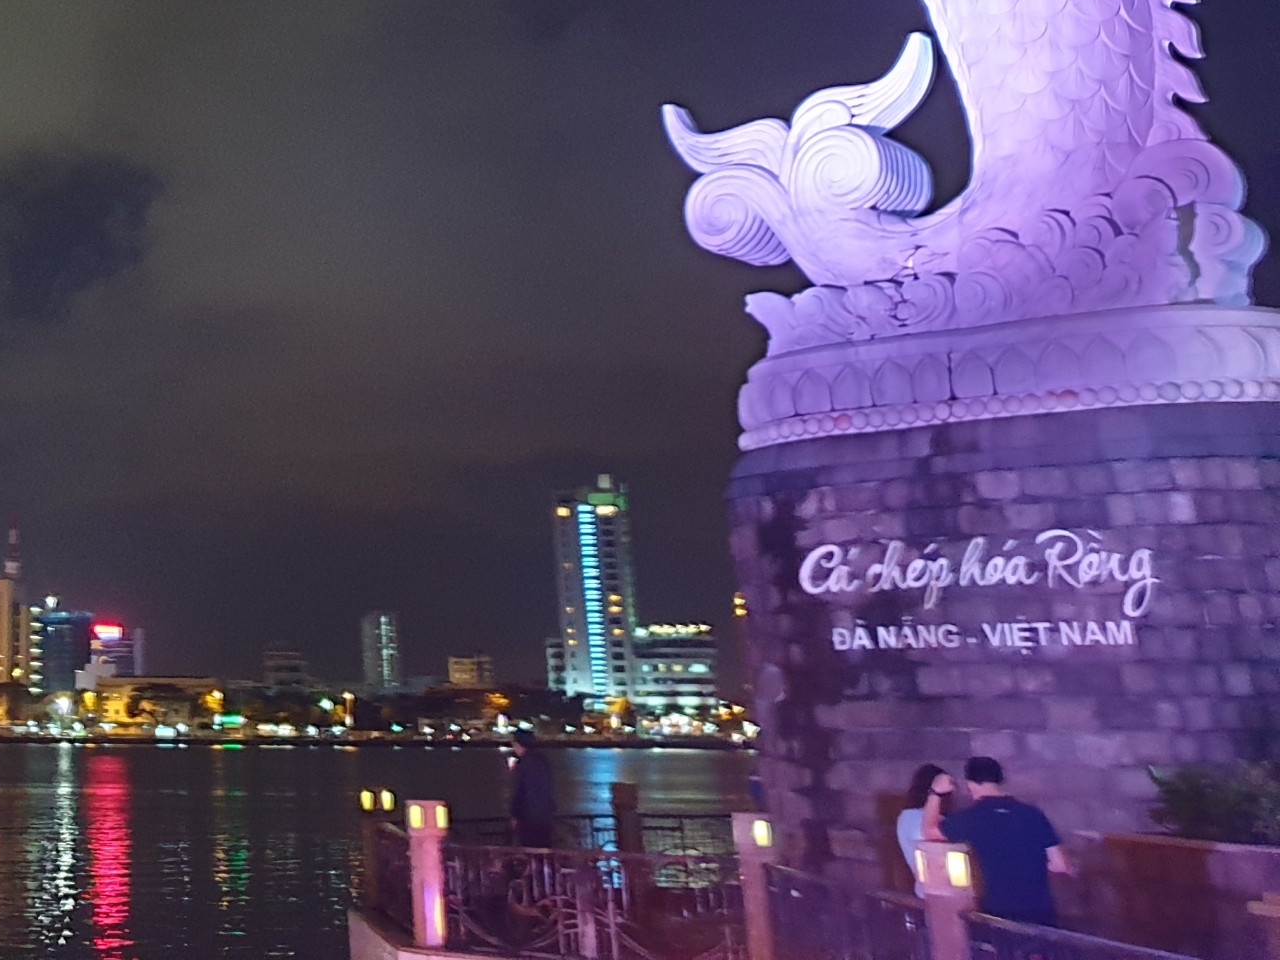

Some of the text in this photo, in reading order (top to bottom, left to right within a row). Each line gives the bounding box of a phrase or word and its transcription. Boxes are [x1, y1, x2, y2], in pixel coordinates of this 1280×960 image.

[866, 539, 955, 610] chép
[959, 537, 1042, 586] hóa
[832, 619, 875, 650] ĐÀ
[981, 615, 1053, 655] VIỆT
[1058, 620, 1134, 646] NAM
